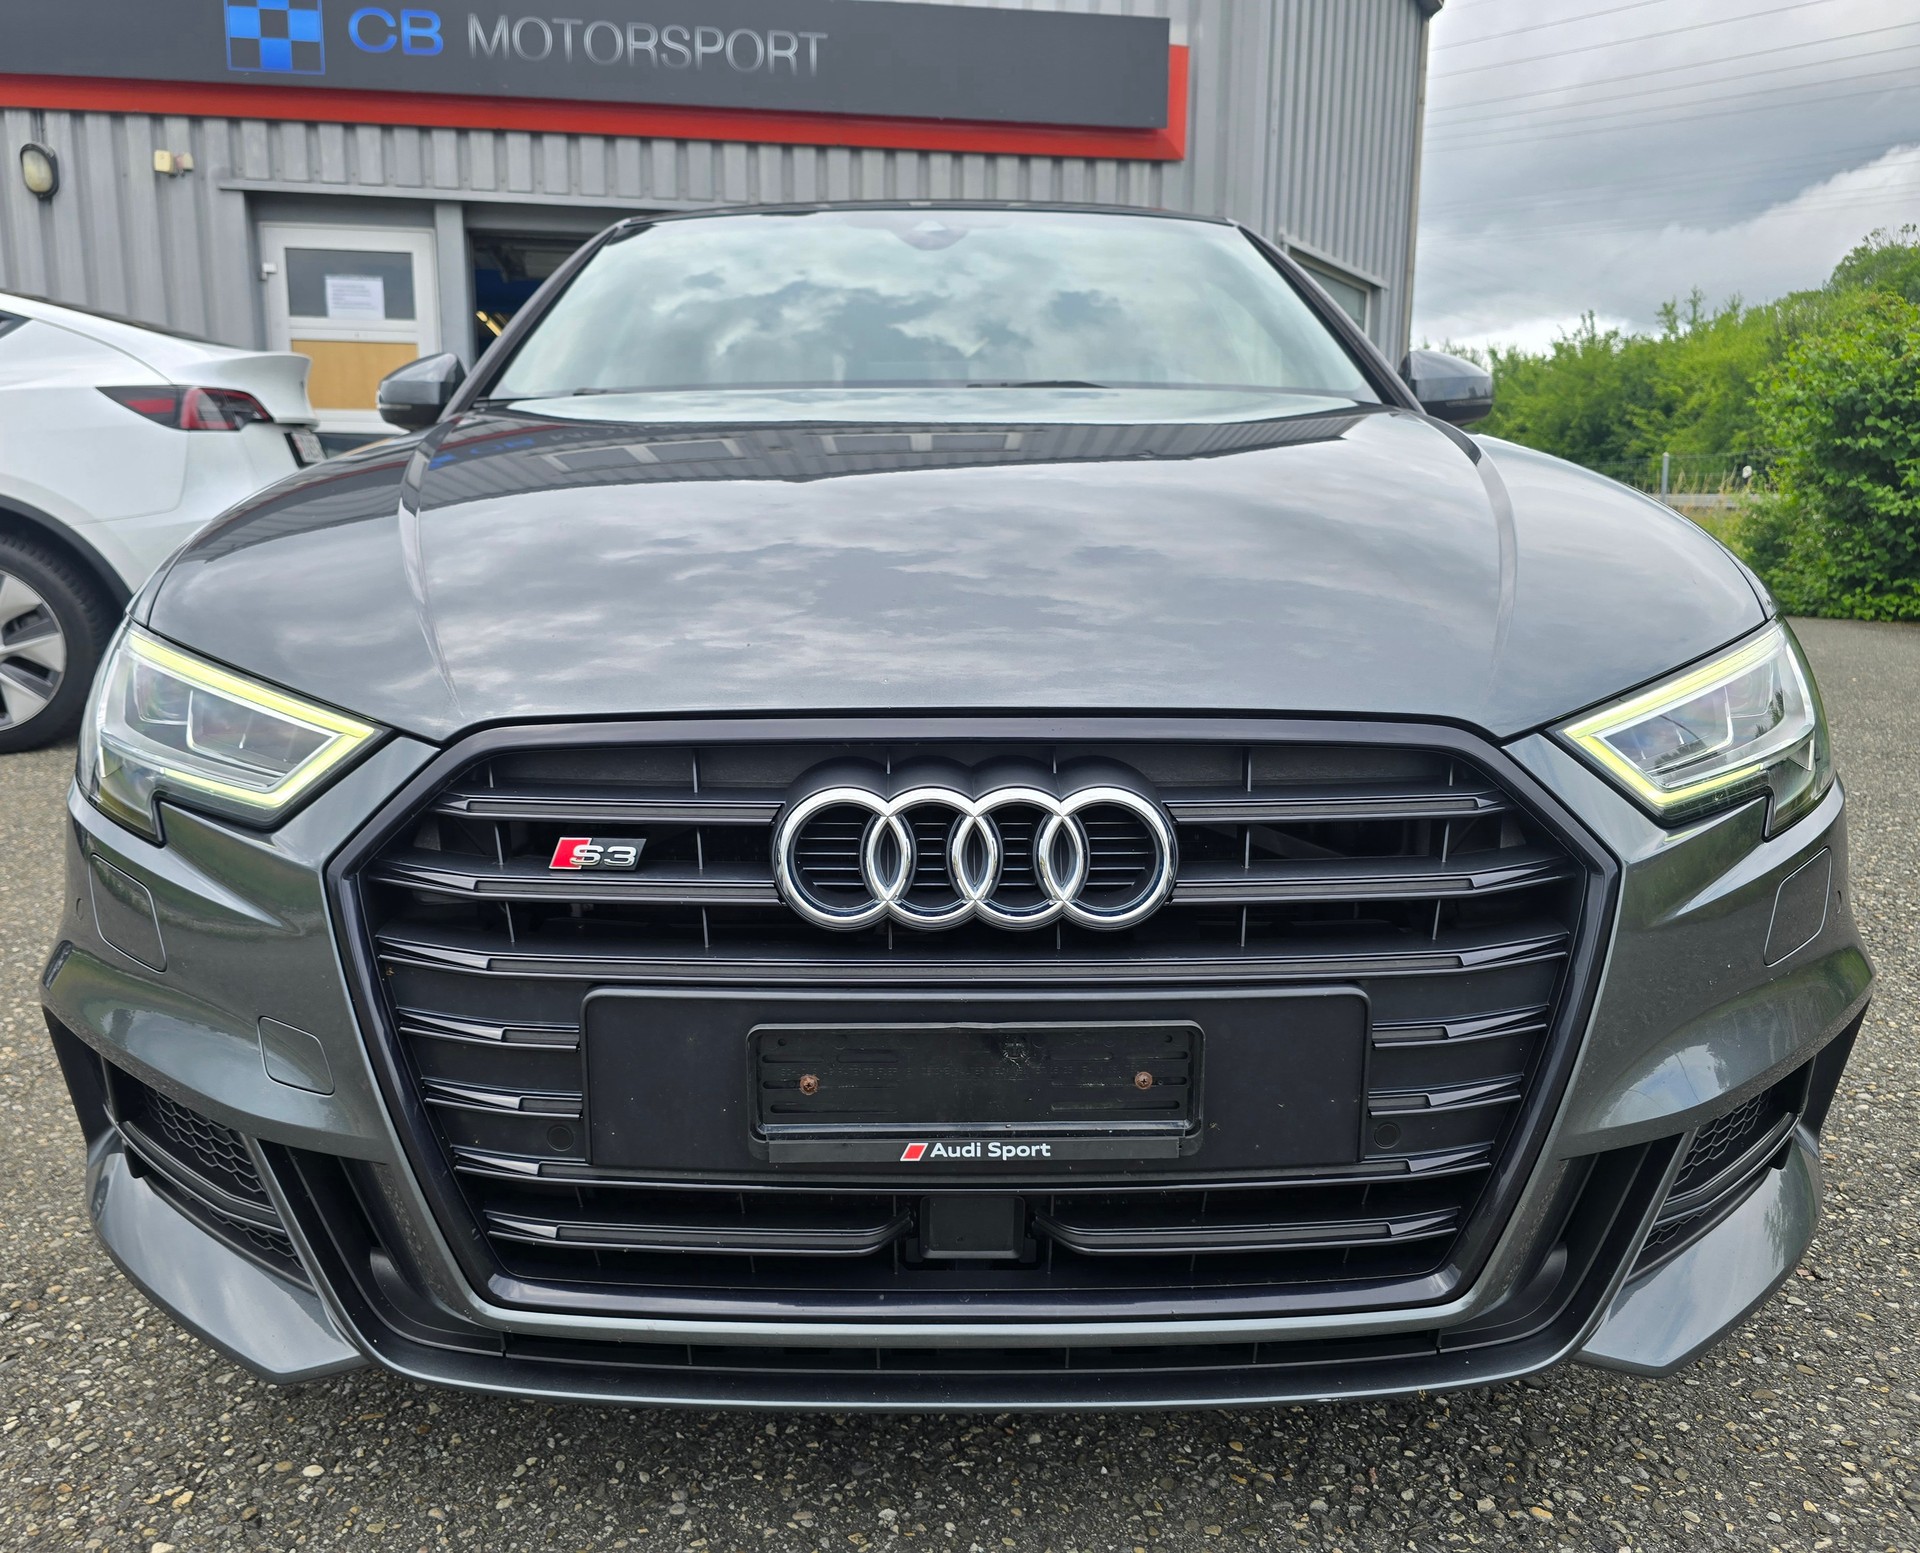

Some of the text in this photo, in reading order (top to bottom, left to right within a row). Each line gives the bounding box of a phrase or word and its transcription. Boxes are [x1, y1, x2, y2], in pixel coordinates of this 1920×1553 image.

[347, 7, 829, 76] CB MOTORSPORT
[569, 844, 637, 867] S3
[930, 1142, 1051, 1161] Audi Sport
